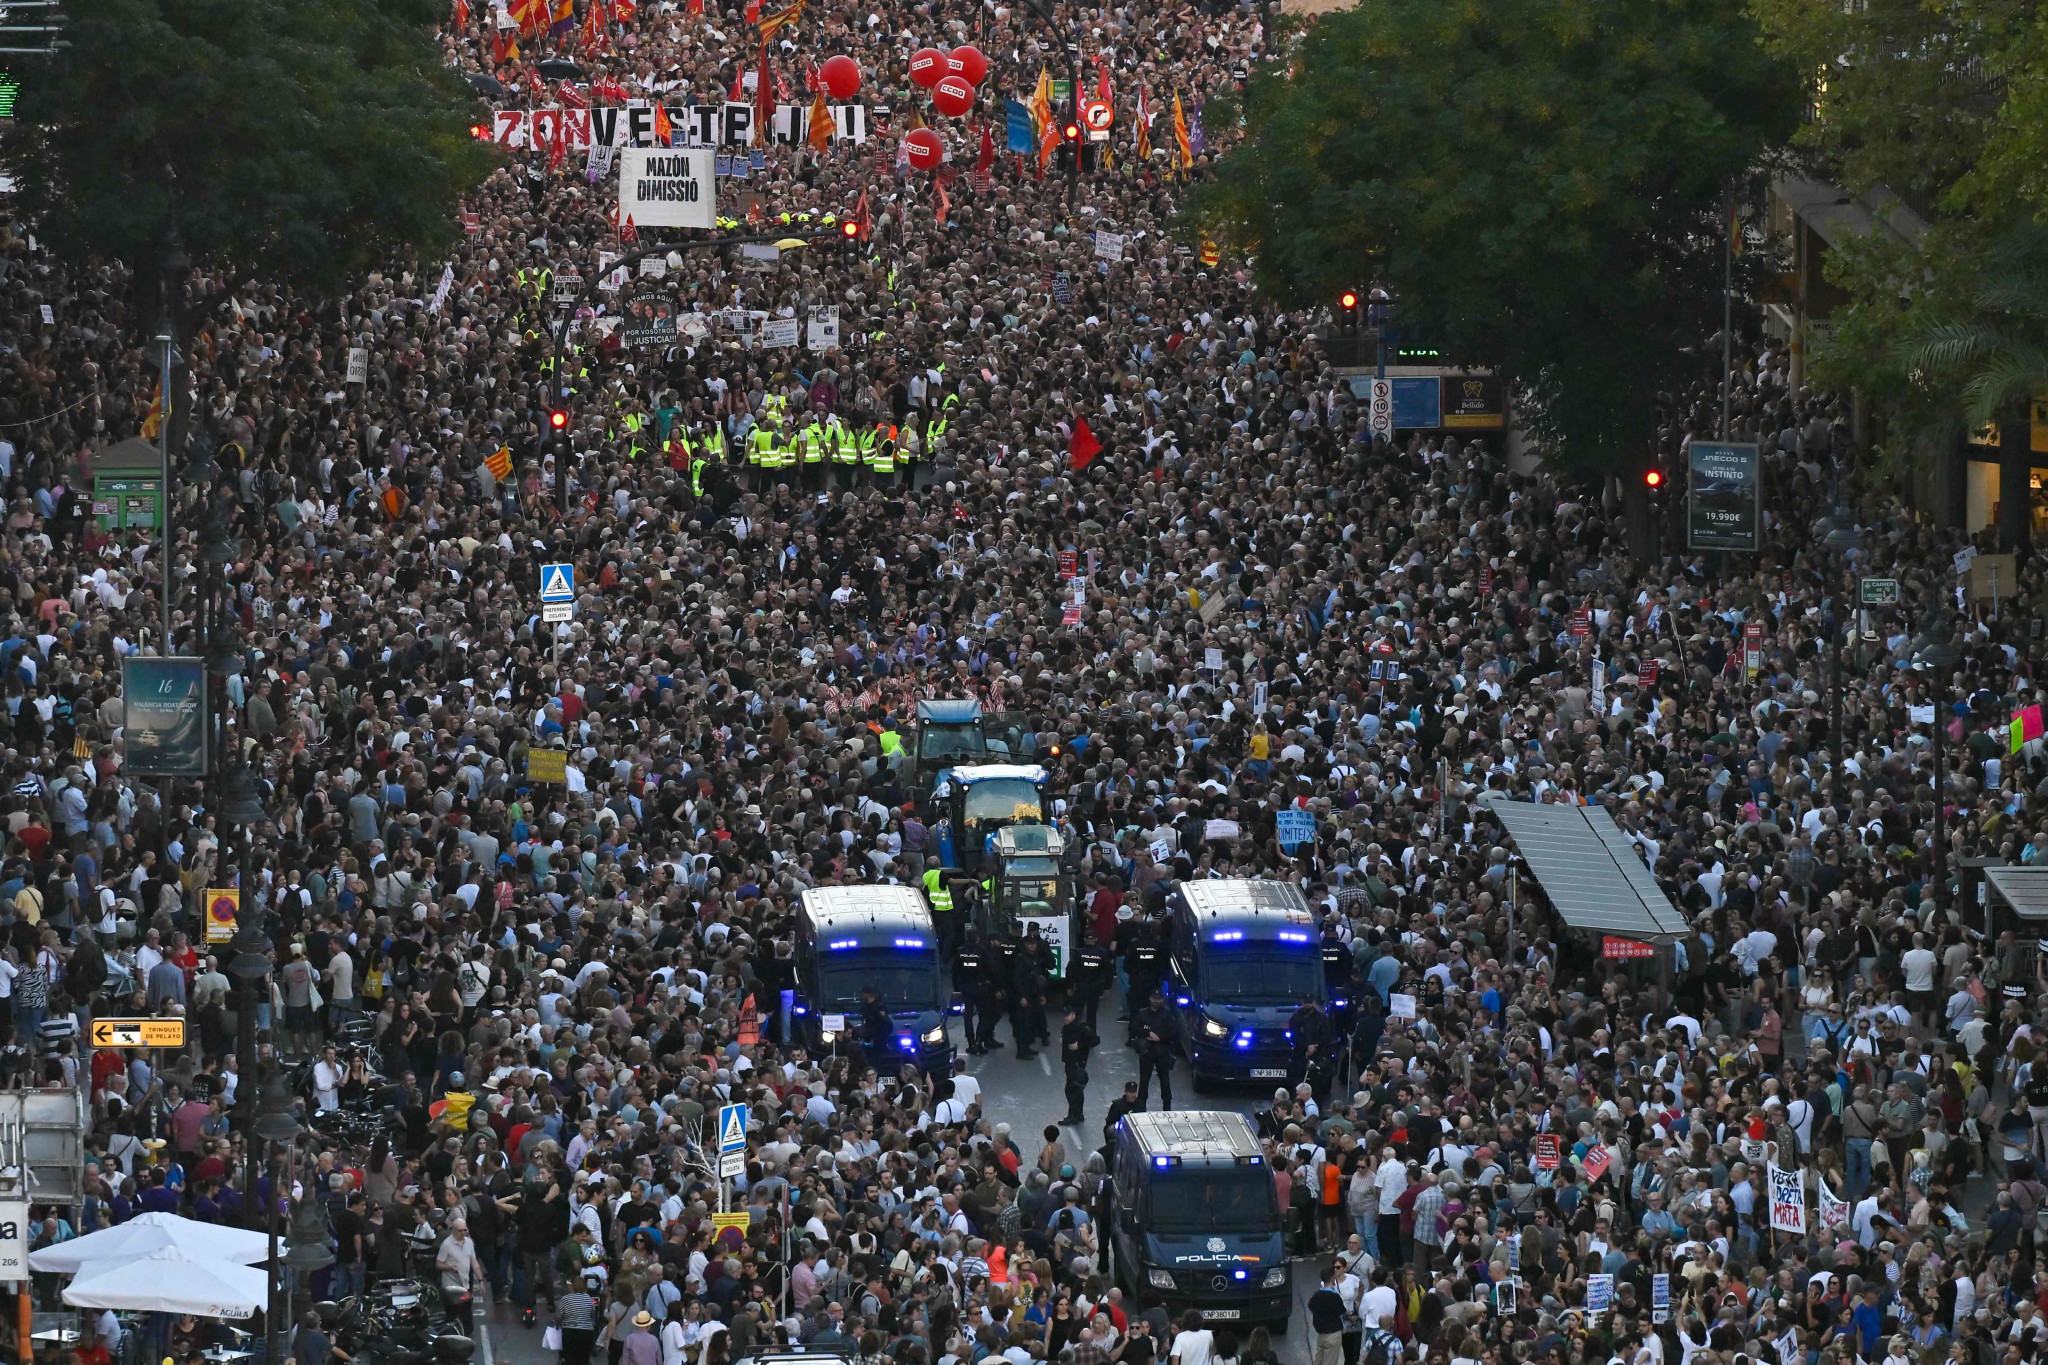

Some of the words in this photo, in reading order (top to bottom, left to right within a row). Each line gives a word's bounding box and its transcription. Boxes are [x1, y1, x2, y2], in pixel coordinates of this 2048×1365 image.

[912, 59, 932, 70] CCOO
[561, 83, 577, 97] UGT
[942, 85, 964, 97] CCOO
[907, 143, 928, 155] CCOO
[646, 154, 690, 178] MAZÓN
[637, 178, 699, 202] DIMISSIÓ
[625, 293, 655, 308] ESTAMOS
[657, 294, 674, 304] AQUÍ
[1375, 402, 1386, 411] 10
[1461, 401, 1485, 409] Bellido
[1702, 455, 1739, 463] JAECOO
[1705, 470, 1744, 479] INSTINTO
[1705, 512, 1740, 521] 19.990€
[158, 679, 173, 694] 16
[1278, 826, 1315, 841] DIMITEIX
[1037, 922, 1059, 934] orta
[1252, 1069, 1287, 1077] CNP3817AZ
[721, 1156, 744, 1166] PREFERENCIA
[1776, 1185, 1804, 1205] DRETA
[1773, 1201, 1801, 1228] MATA
[2, 1258, 18, 1266] 206
[1175, 1254, 1242, 1263] POLICIA
[1203, 1311, 1239, 1319] CNP3801AP
